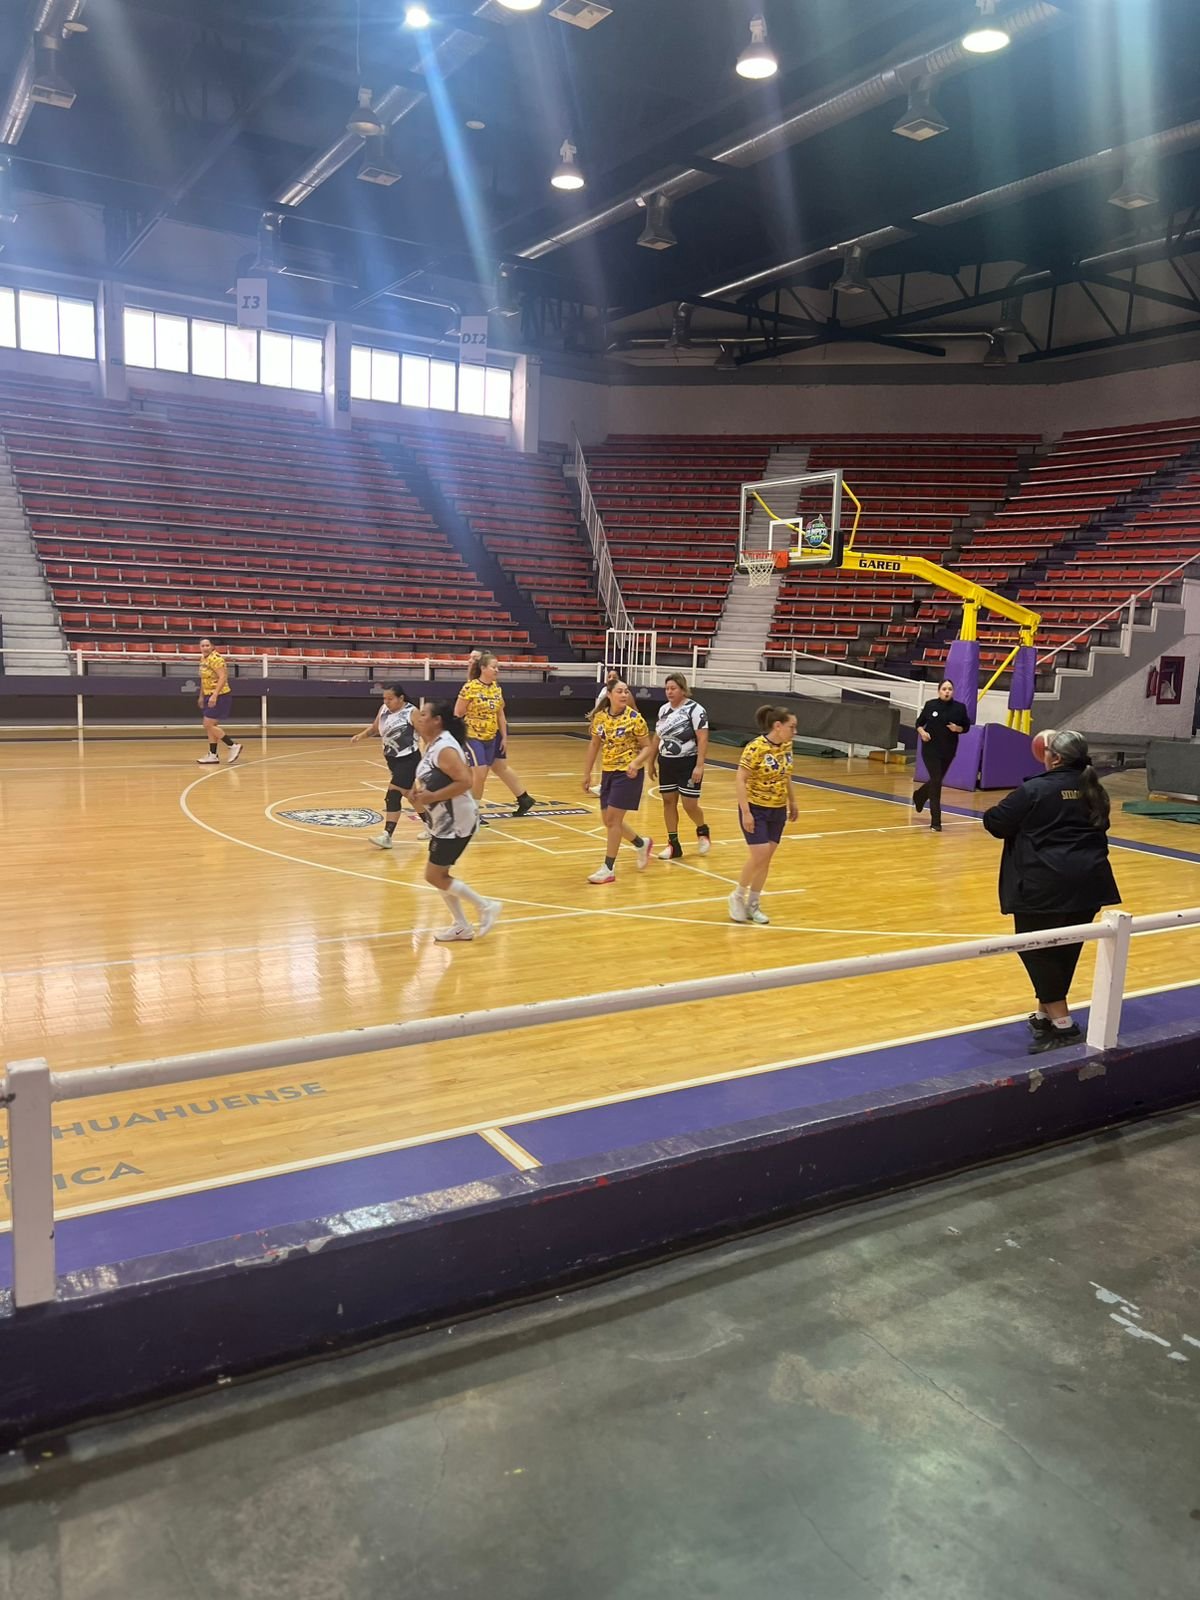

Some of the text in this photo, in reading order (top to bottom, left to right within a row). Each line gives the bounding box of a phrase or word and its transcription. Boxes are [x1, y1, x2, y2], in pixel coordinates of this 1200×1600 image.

[241, 295, 260, 309] I3
[461, 333, 486, 344] DI2
[858, 559, 901, 571] GARED
[51, 1081, 327, 1140] HUAHUENSE
[52, 1161, 145, 1190] ICA
